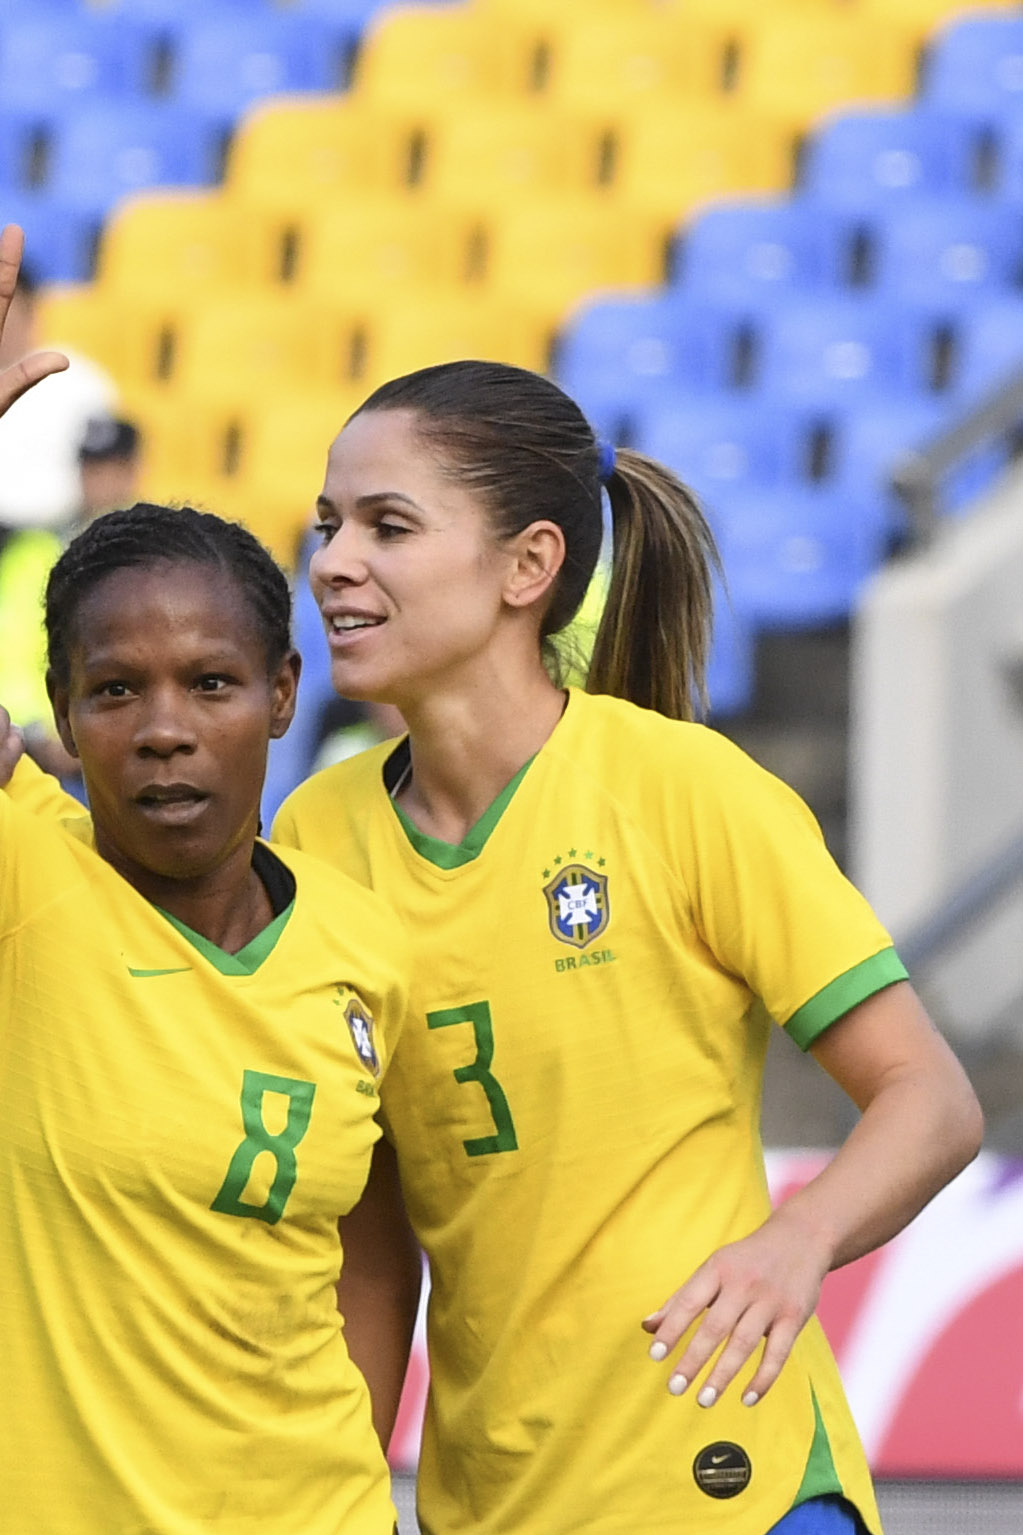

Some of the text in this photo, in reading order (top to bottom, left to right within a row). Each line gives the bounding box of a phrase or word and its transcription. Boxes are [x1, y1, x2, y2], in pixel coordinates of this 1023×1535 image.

[567, 899, 587, 910] CBF
[554, 949, 616, 973] BRASIL
[426, 1000, 519, 1157] 3
[209, 1069, 316, 1225] 8
